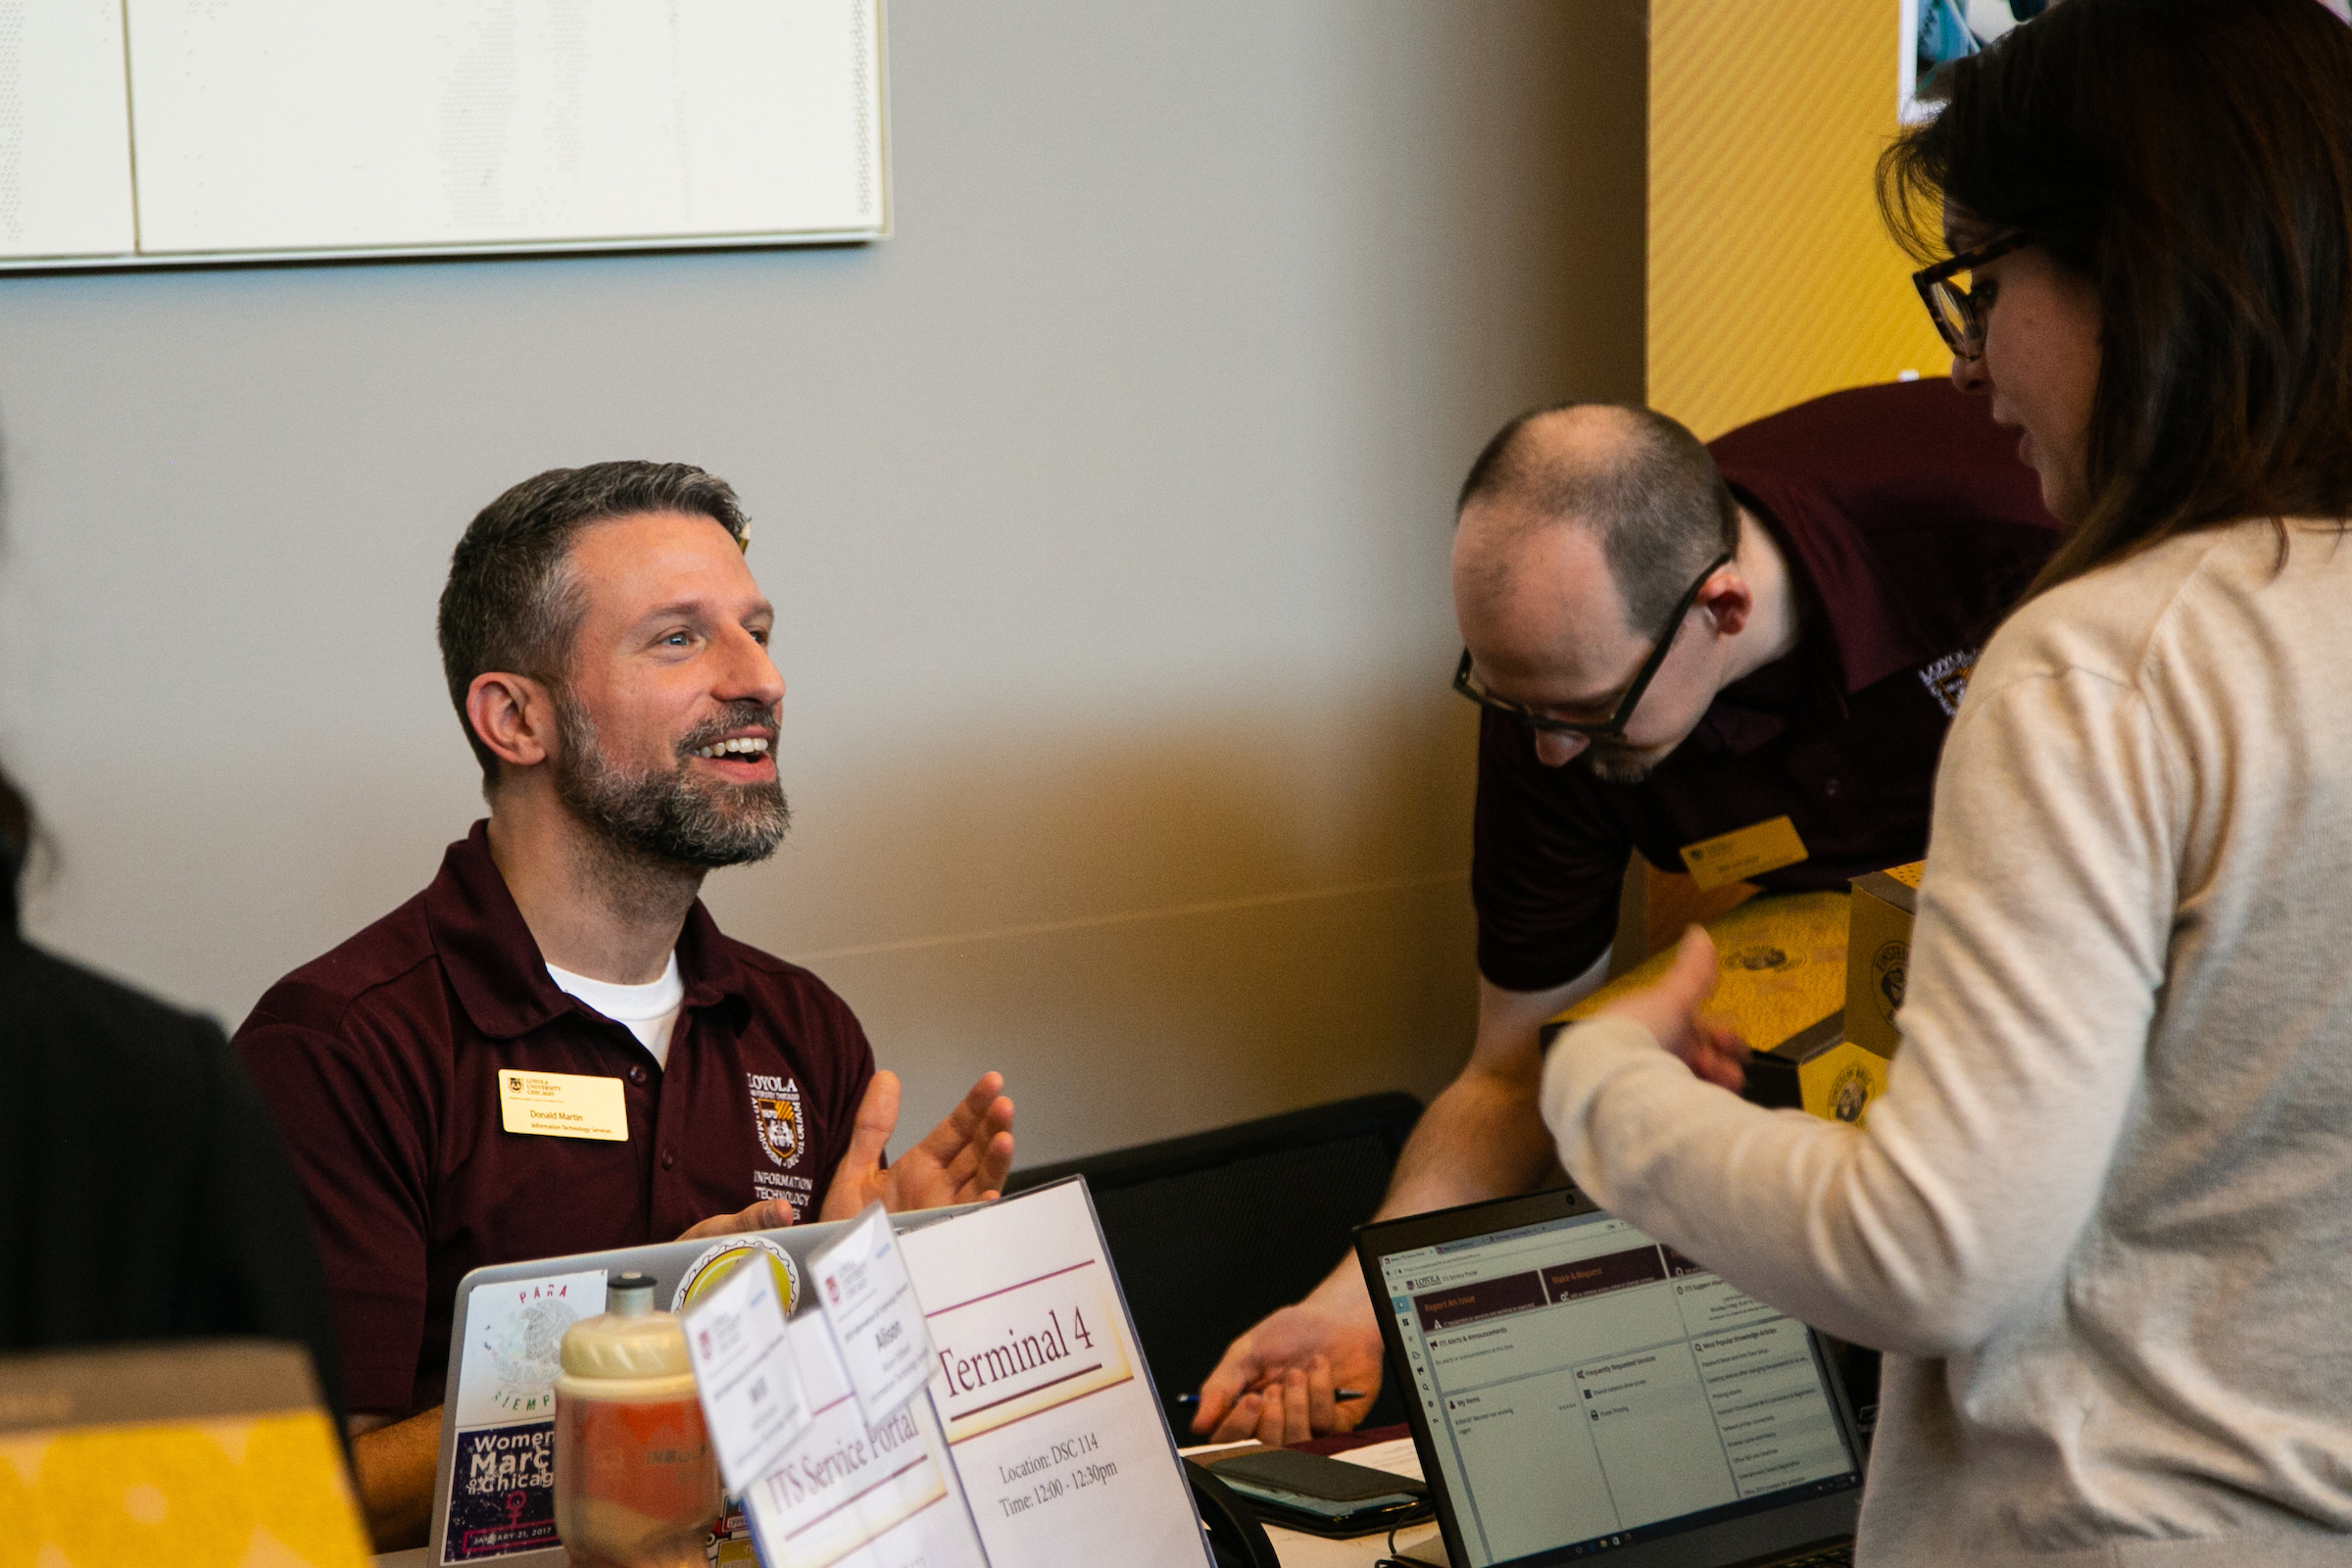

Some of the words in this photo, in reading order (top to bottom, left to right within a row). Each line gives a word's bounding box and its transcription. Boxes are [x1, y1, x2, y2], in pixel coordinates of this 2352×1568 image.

[1876, 945, 1907, 973] EINSTEI
[746, 1072, 799, 1094] LOYOLA
[530, 1109, 557, 1120] Donald
[559, 1112, 583, 1122] Martin
[562, 1124, 590, 1134] Technology
[754, 1170, 812, 1192] INFORMATION
[754, 1186, 810, 1206] TECHNOLOGY
[1414, 1274, 1441, 1286] LOYOLA
[1550, 1273, 1569, 1285] Make
[1569, 1271, 1577, 1280] A
[1575, 1266, 1603, 1279] Request
[1423, 1299, 1447, 1313] Report
[1446, 1298, 1458, 1308] An
[1456, 1294, 1476, 1305] Issue
[1467, 1326, 1507, 1340] Announcements
[1715, 1338, 1733, 1347] Popular
[1734, 1332, 1759, 1343] Knowledge
[1759, 1328, 1777, 1337] Articles
[938, 1308, 1071, 1398] Terminal
[1074, 1305, 1094, 1350] 4
[1584, 1365, 1611, 1378] Frequently
[1610, 1359, 1637, 1372] Requested
[1636, 1355, 1657, 1366] Services
[492, 1392, 550, 1411] SIEMP
[1465, 1396, 1481, 1404] Items
[474, 1431, 555, 1452] Women
[470, 1449, 551, 1479] Marc
[764, 1464, 805, 1515] ITS
[801, 1439, 867, 1495] Service
[863, 1402, 919, 1459] Portal
[999, 1454, 1052, 1485] Location:
[1051, 1439, 1078, 1465] DSC
[1078, 1432, 1099, 1453] 114
[480, 1470, 555, 1494] Chicag
[999, 1495, 1034, 1518] Time:
[1034, 1478, 1063, 1504] 12:00
[1071, 1461, 1118, 1490] 12:30pm
[472, 1533, 515, 1545] JANUARY
[517, 1530, 528, 1539] 21,
[532, 1527, 551, 1537] 2017
